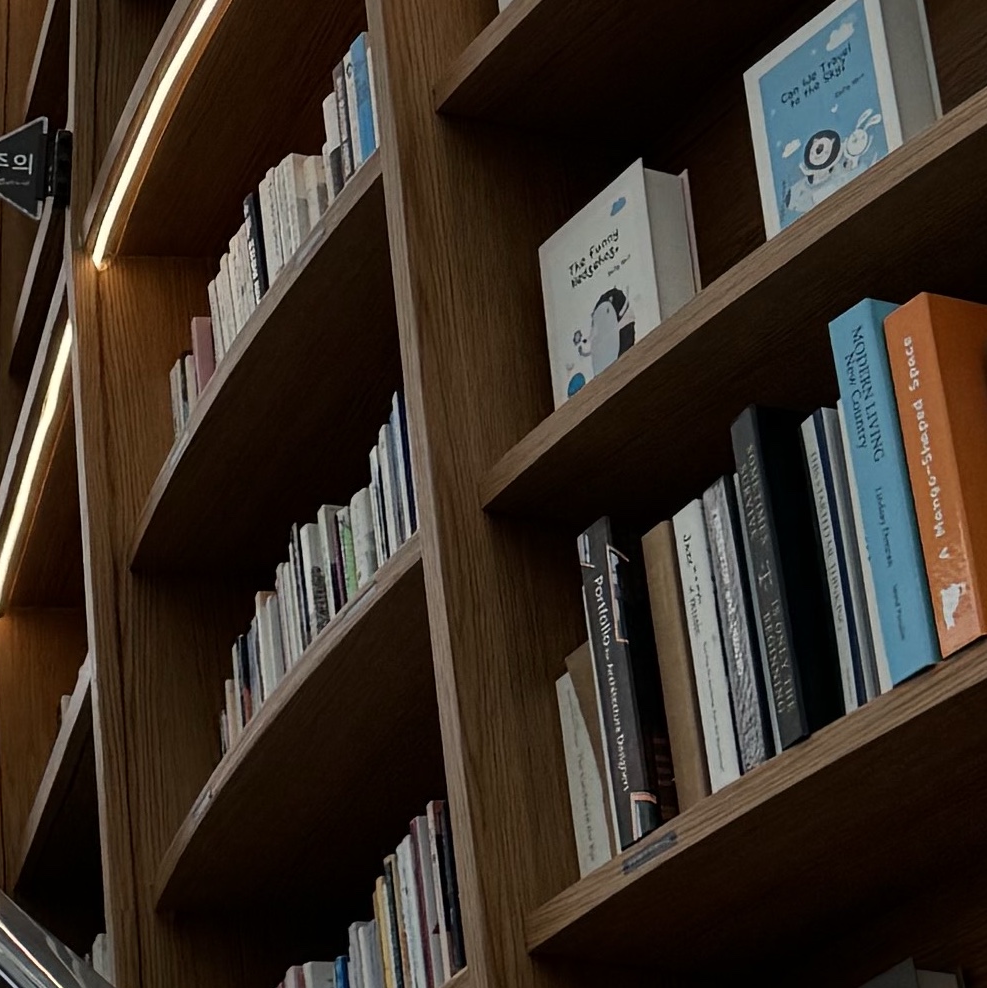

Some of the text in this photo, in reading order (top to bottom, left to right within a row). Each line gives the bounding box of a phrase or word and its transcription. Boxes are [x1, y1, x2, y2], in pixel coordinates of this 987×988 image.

[781, 86, 799, 104] Can
[820, 41, 851, 71] Travel
[790, 97, 800, 108] to
[804, 81, 820, 98] the
[569, 257, 585, 276] The
[590, 228, 619, 258] Funny
[845, 353, 867, 449] New Country
[852, 325, 885, 462] MODERN LIVING
[904, 336, 951, 559] A Mango-Shaped Space
[594, 574, 612, 646] Portfolio
